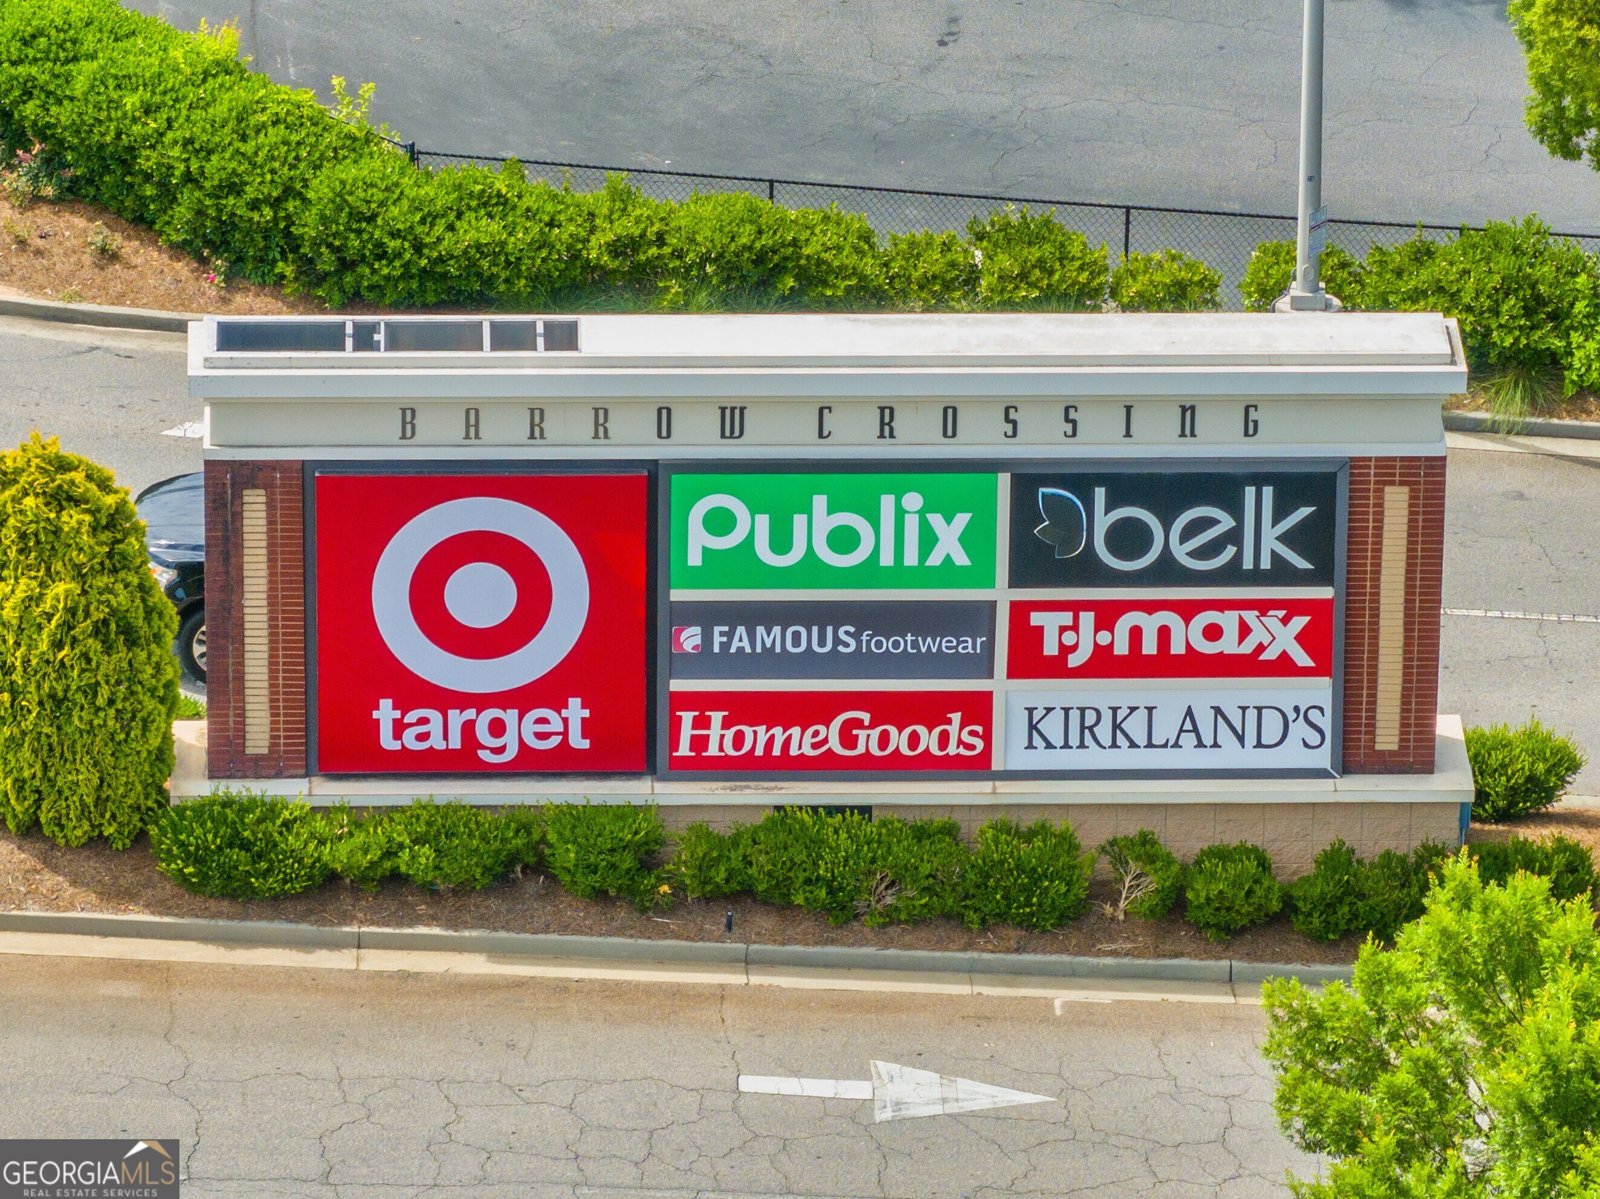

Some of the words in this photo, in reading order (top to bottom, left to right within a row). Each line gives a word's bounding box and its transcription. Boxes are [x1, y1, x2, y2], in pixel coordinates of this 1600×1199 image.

[398, 406, 748, 440] BARROW
[817, 404, 1259, 440] CROSSING
[687, 491, 973, 568] Publix
[1093, 486, 1318, 571] belk
[713, 625, 857, 654] FAMOUS
[860, 630, 987, 655] footwear
[372, 697, 591, 764] target
[672, 710, 985, 757] HomeGoods
[1023, 704, 1327, 750] KIRKLAND'S
